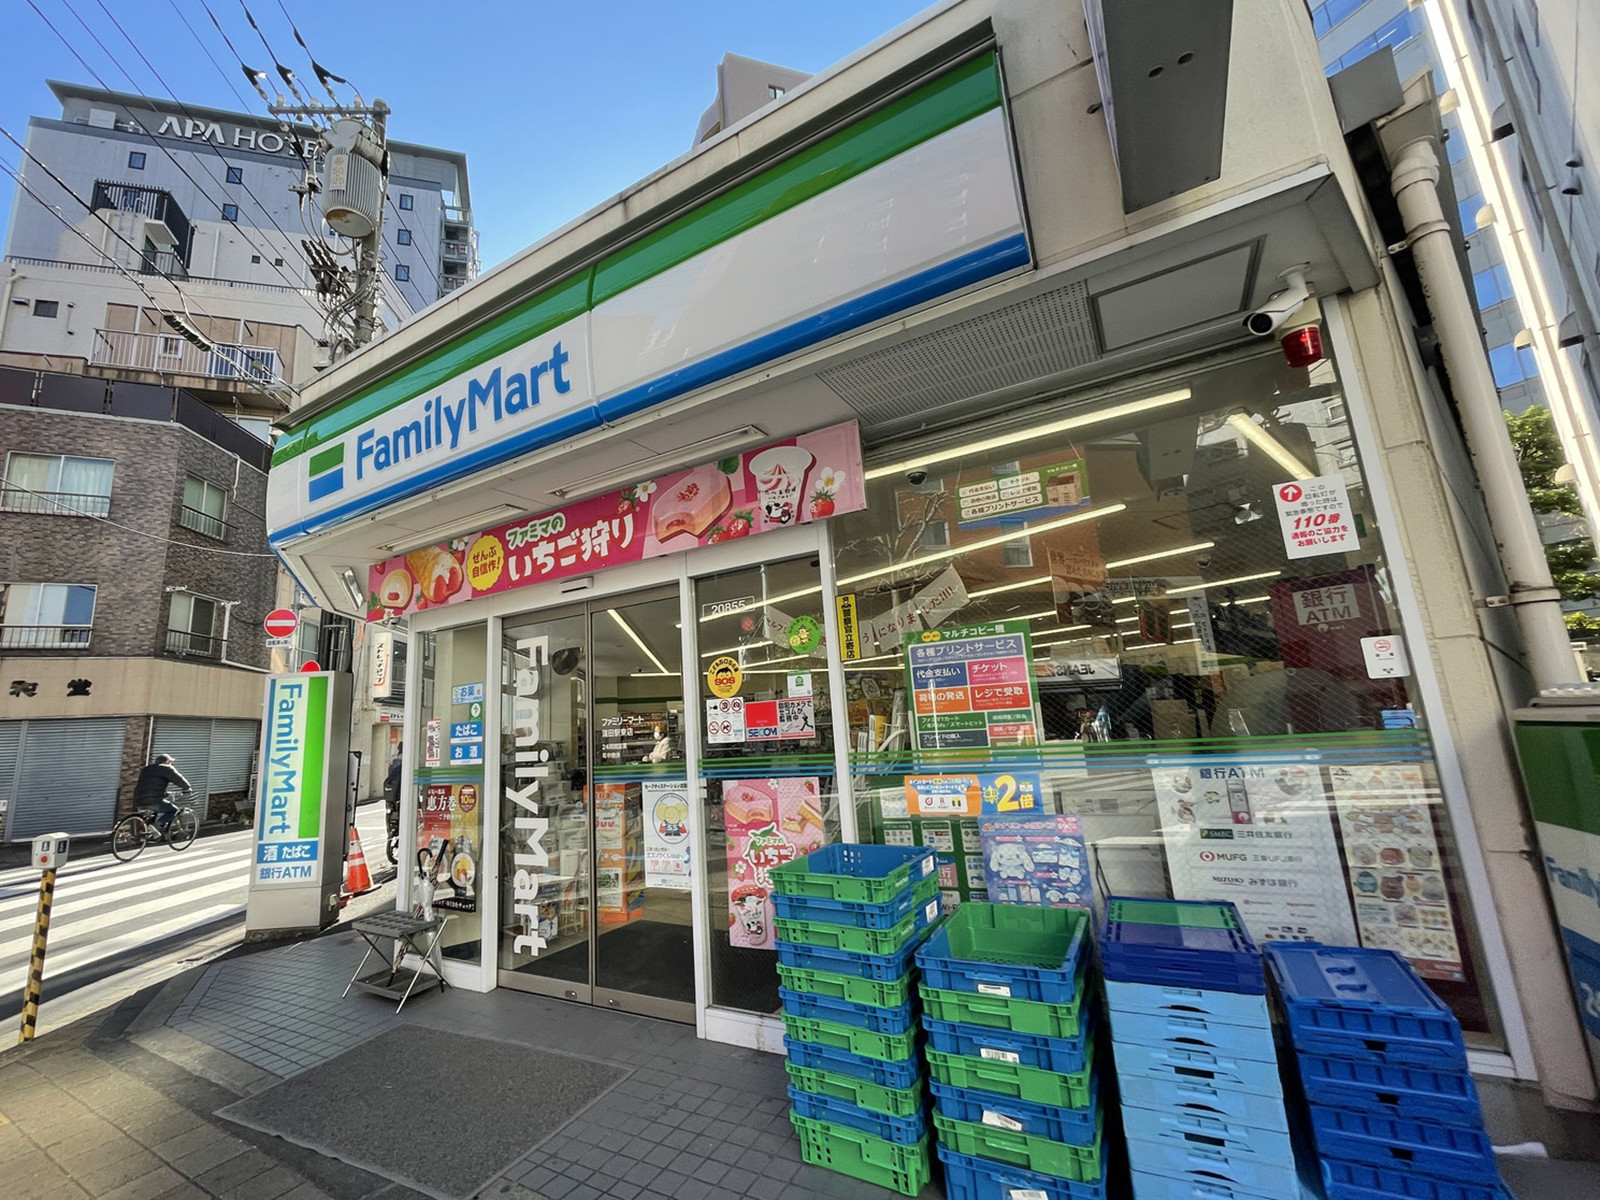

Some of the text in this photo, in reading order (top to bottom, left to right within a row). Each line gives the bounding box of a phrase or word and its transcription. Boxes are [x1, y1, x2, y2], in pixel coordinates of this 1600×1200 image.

[158, 116, 225, 144] APA
[356, 341, 571, 480] FamilyMart
[971, 496, 1040, 515] 各種プリントサービス
[1293, 512, 1341, 529] 110番
[506, 512, 566, 549] ファミマの
[1291, 525, 1348, 539] 通報のご協力を
[508, 511, 636, 581] いちご狩り
[1297, 534, 1346, 547] お願いします
[472, 545, 498, 563] ぜんぶ
[1301, 586, 1348, 608] 銀行
[1305, 606, 1352, 623] ATM
[942, 624, 1005, 638] マルチコピー機
[916, 639, 1017, 657] 各種プリントサービス
[916, 668, 960, 679] 代金支払い
[972, 662, 1007, 673] チケット
[714, 677, 736, 686] SOS
[919, 691, 965, 703] 荷物の発送
[974, 686, 1024, 699] レジで受取
[779, 707, 803, 716] セコムが
[779, 714, 799, 722] 監視中
[601, 715, 644, 727] ファミリーマート
[455, 724, 477, 736] たばこ
[748, 728, 777, 737] SECOM
[268, 683, 303, 835] FamilyMart
[1199, 767, 1265, 779] 銀行ATM
[426, 795, 457, 811] 恵方巻
[506, 635, 549, 957] FamilyMart
[756, 837, 784, 845] ファミマの
[1237, 830, 1293, 839] 三井住友銀行
[263, 845, 311, 861] 酒 たばこ
[1217, 853, 1247, 861] MUFG
[259, 864, 312, 880] 銀行ATM
